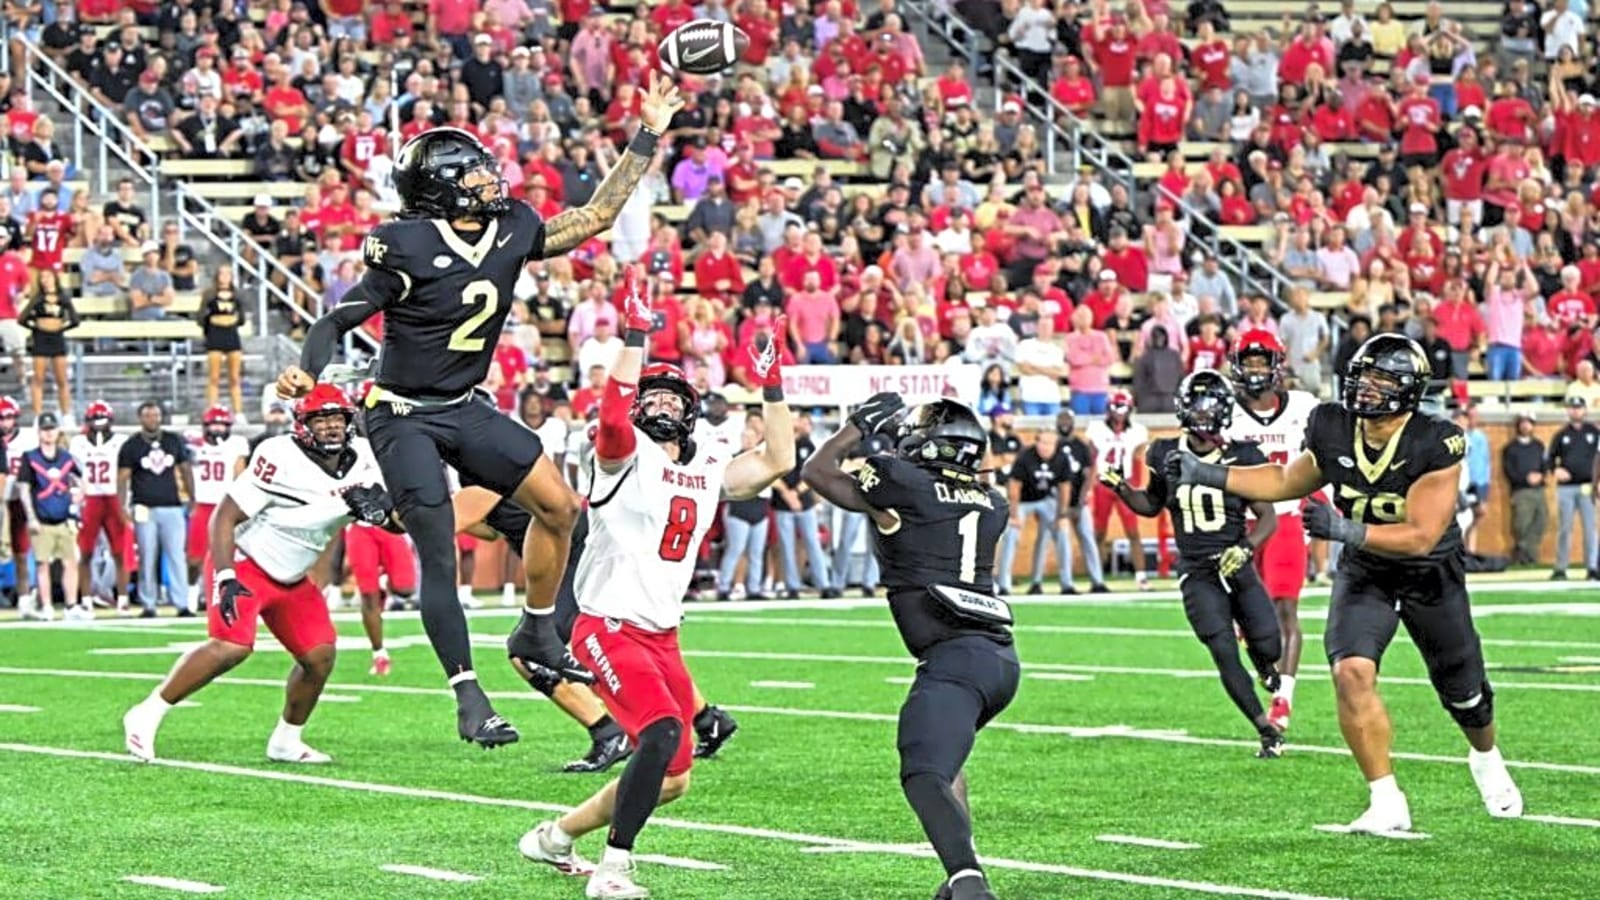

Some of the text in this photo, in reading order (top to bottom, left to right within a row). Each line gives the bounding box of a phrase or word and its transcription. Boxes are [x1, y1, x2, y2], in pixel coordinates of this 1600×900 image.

[37, 229, 59, 252] 17
[366, 235, 388, 264] WF
[447, 279, 499, 351] 2
[1259, 433, 1286, 445] STATE
[85, 460, 110, 484] 32
[199, 459, 225, 481] 30
[253, 455, 278, 485] 52
[661, 466, 708, 490] NC STATE
[1176, 483, 1227, 533] 10
[658, 494, 697, 563] 8
[958, 510, 981, 584] 1
[585, 632, 622, 696] WOLFPACK
